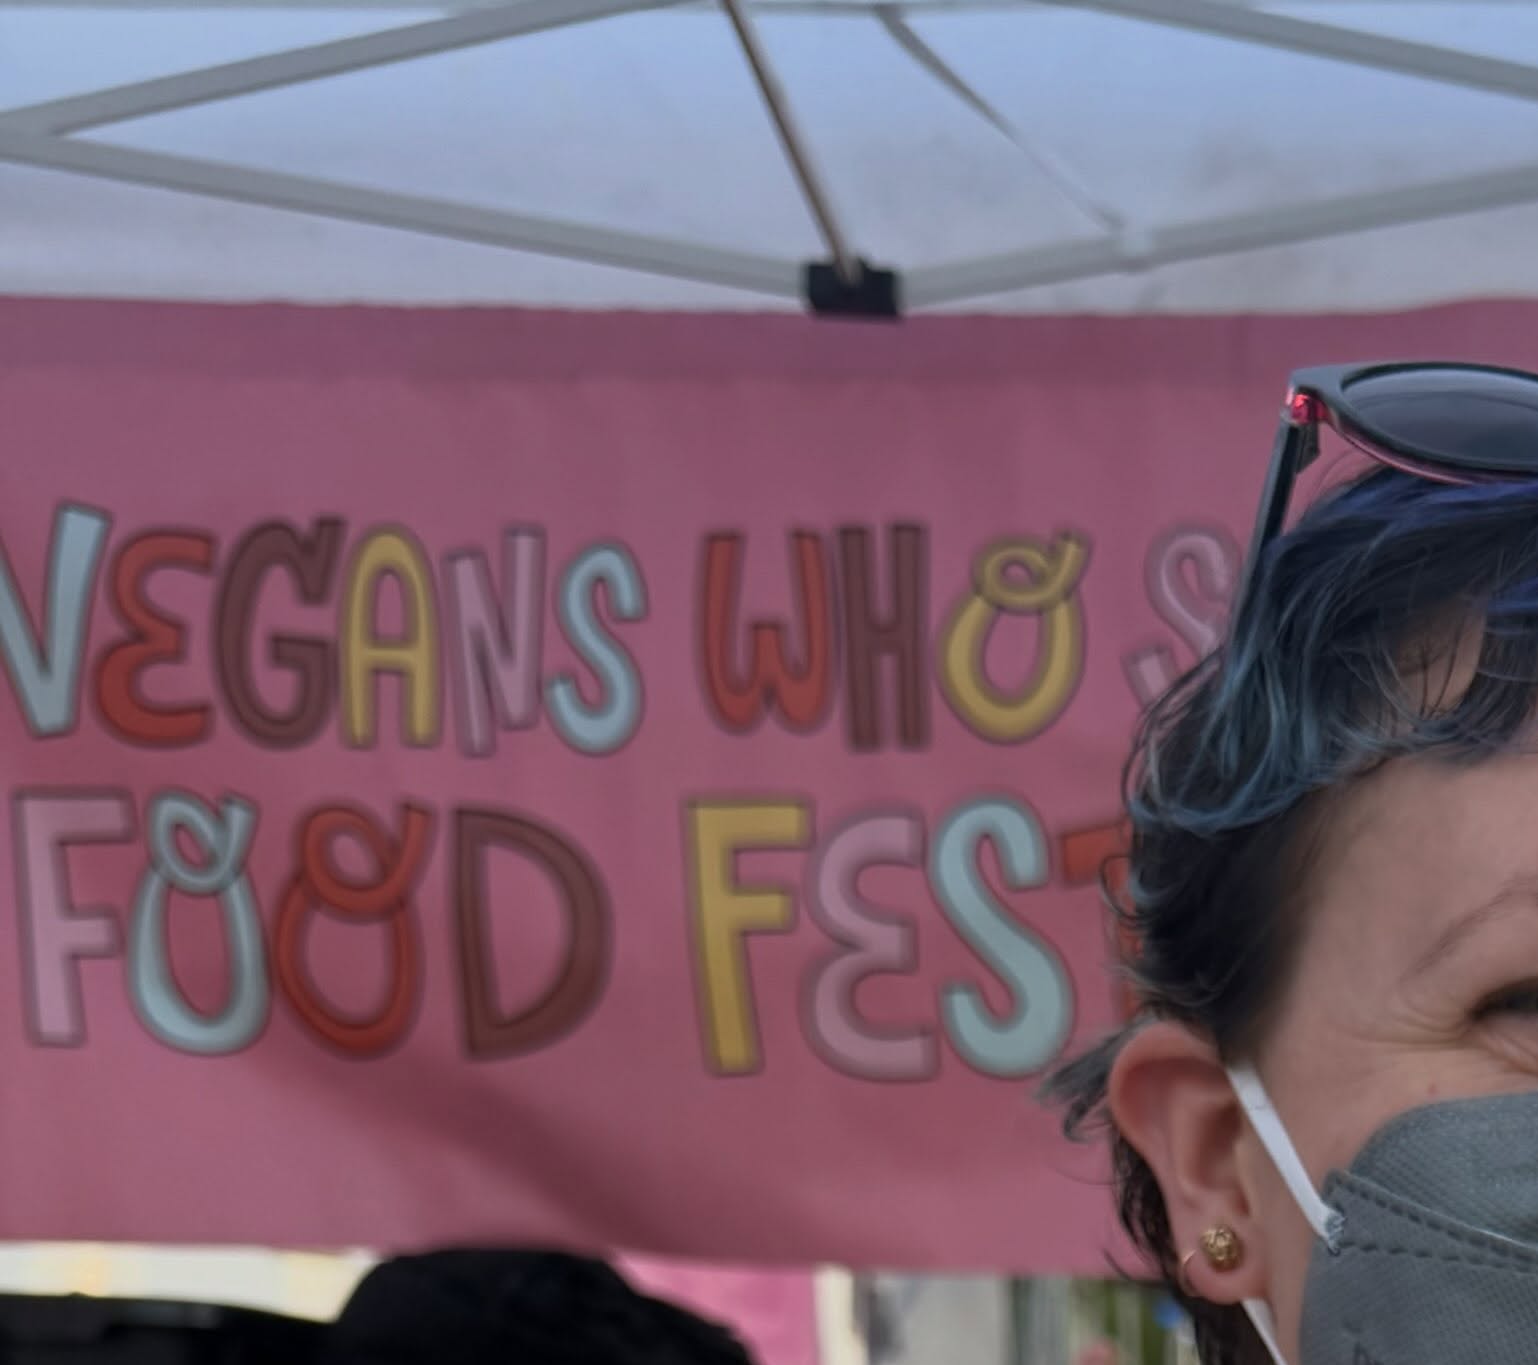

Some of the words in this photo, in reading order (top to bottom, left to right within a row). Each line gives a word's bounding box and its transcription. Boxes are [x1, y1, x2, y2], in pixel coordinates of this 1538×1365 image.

[0, 501, 647, 757] VEGANS
[696, 521, 1090, 751] WHO
[12, 783, 616, 1064] FOOD
